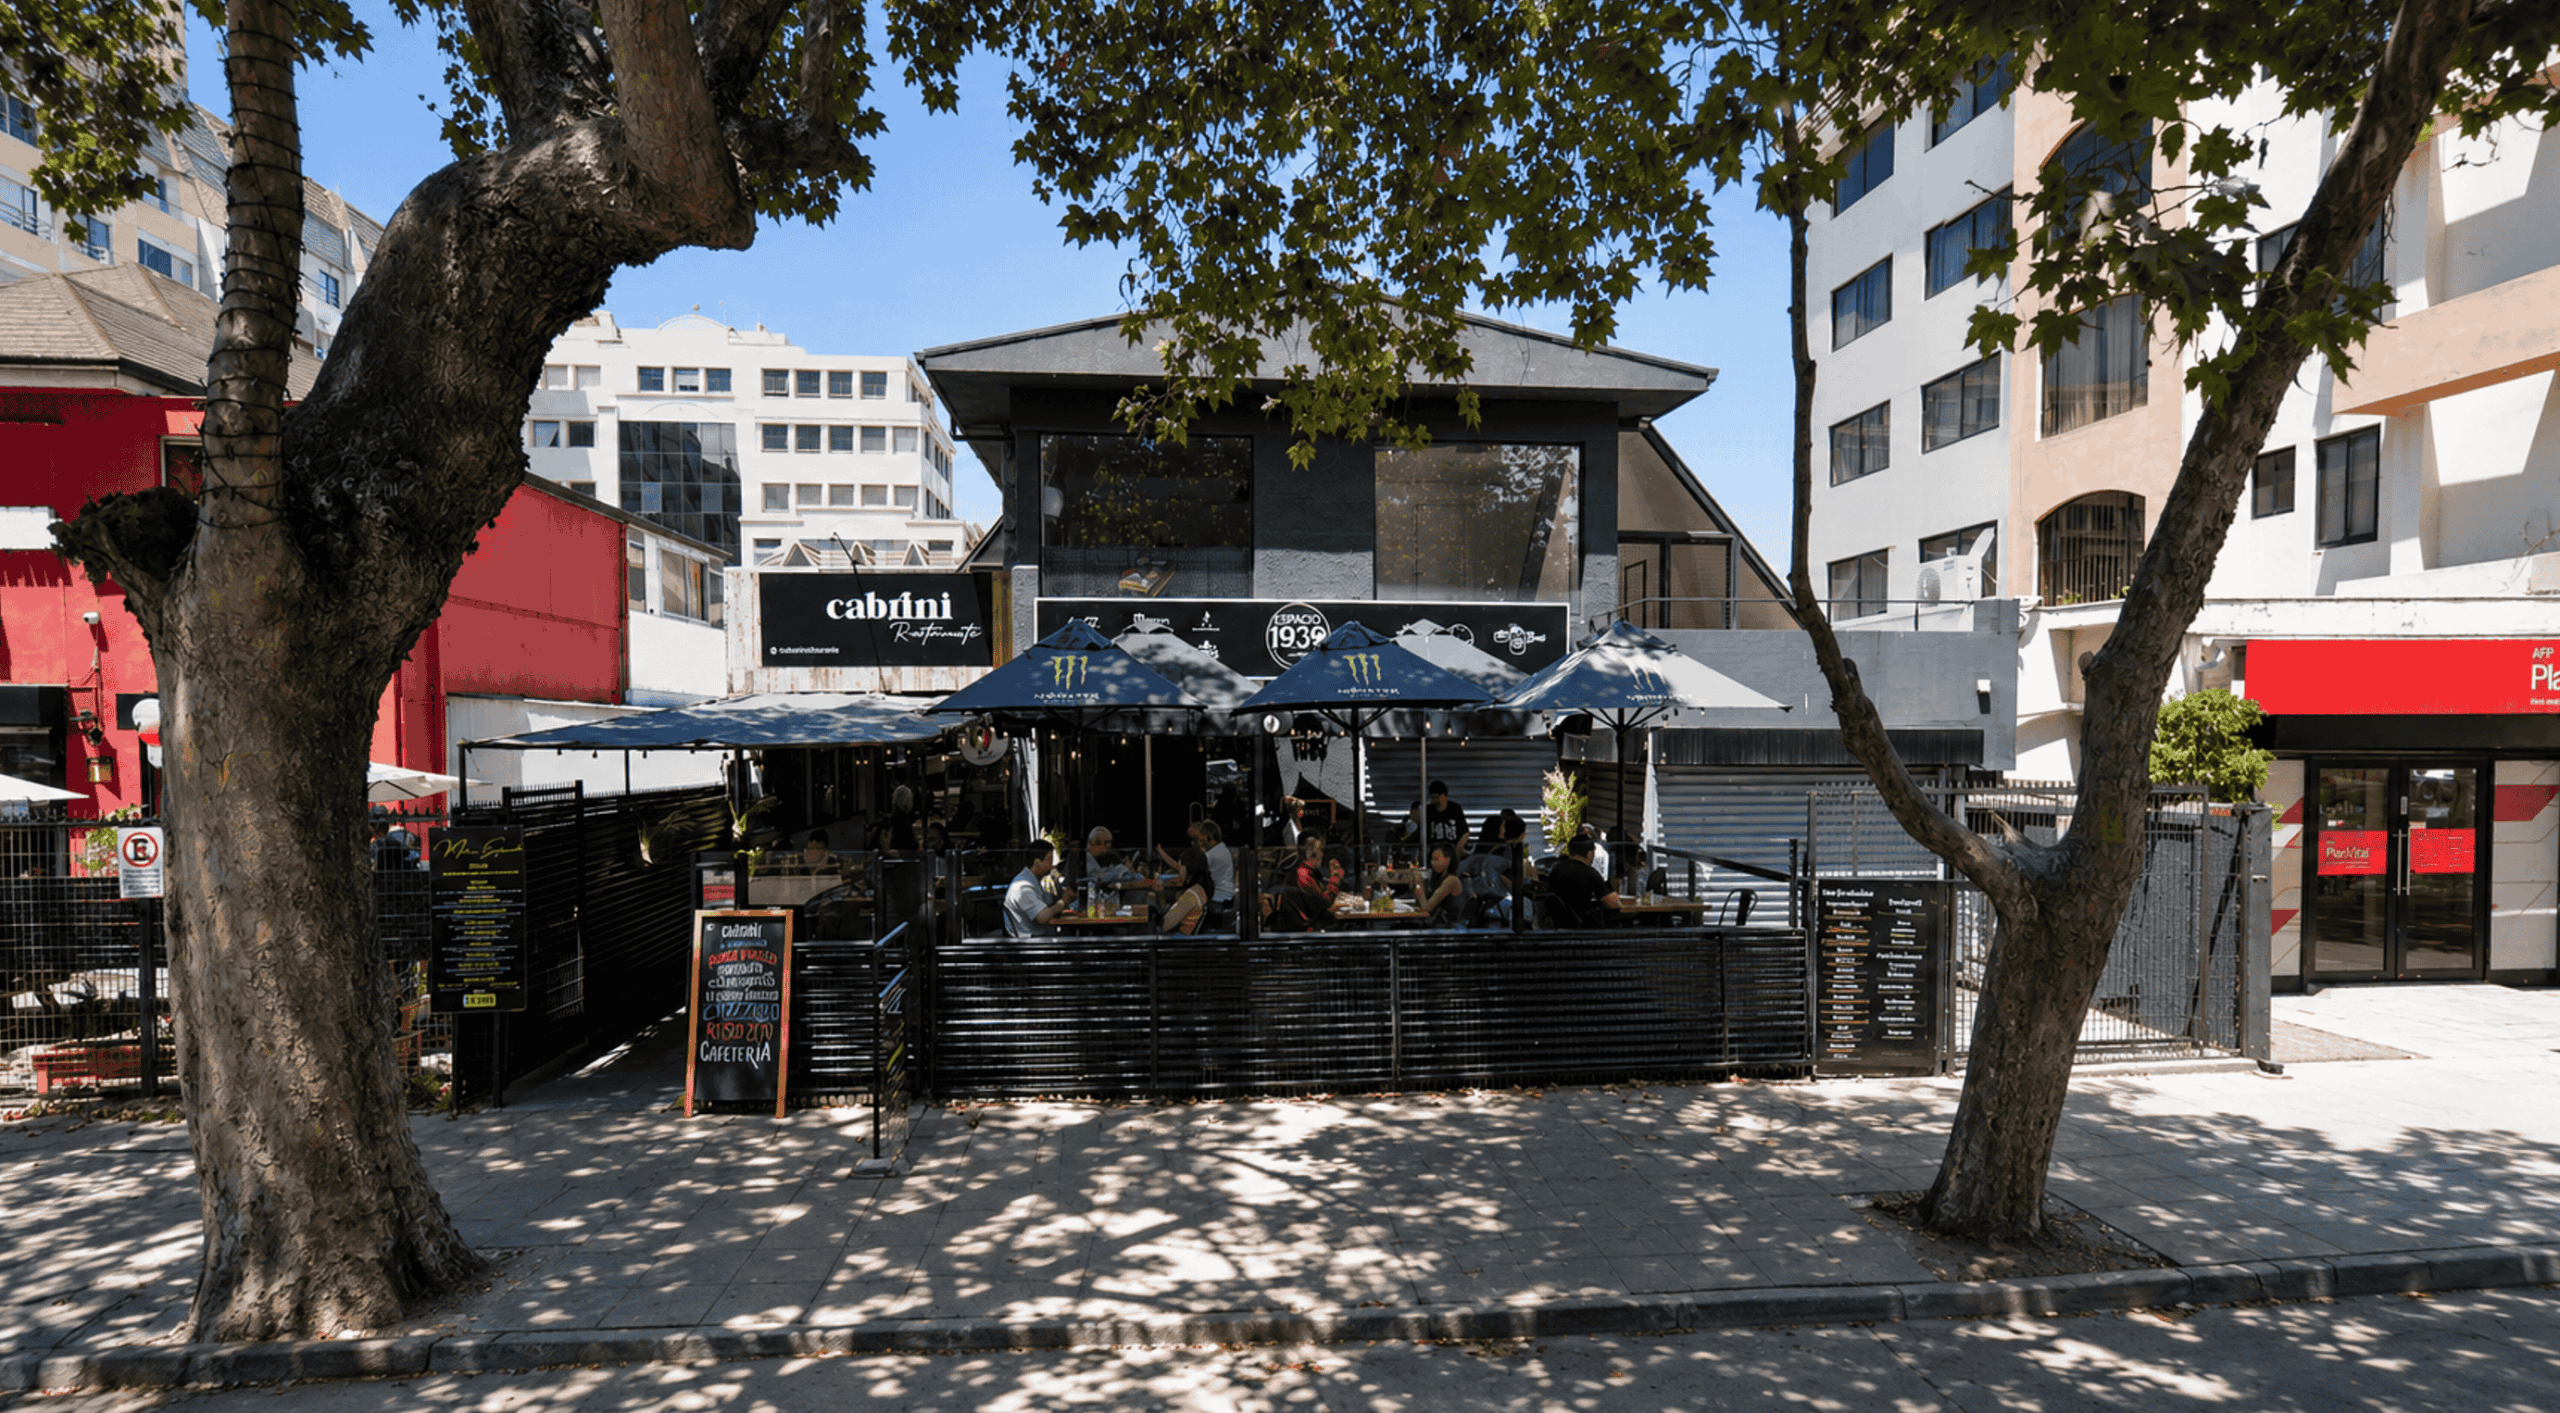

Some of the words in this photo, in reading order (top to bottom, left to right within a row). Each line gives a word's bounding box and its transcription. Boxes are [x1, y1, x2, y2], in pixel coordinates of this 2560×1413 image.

[826, 591, 953, 620] cabrini
[1274, 614, 1321, 625] ESPACIO
[1270, 625, 1327, 649] 1939
[2531, 647, 2554, 658] AFP
[700, 1040, 771, 1070] CAFETERIA
